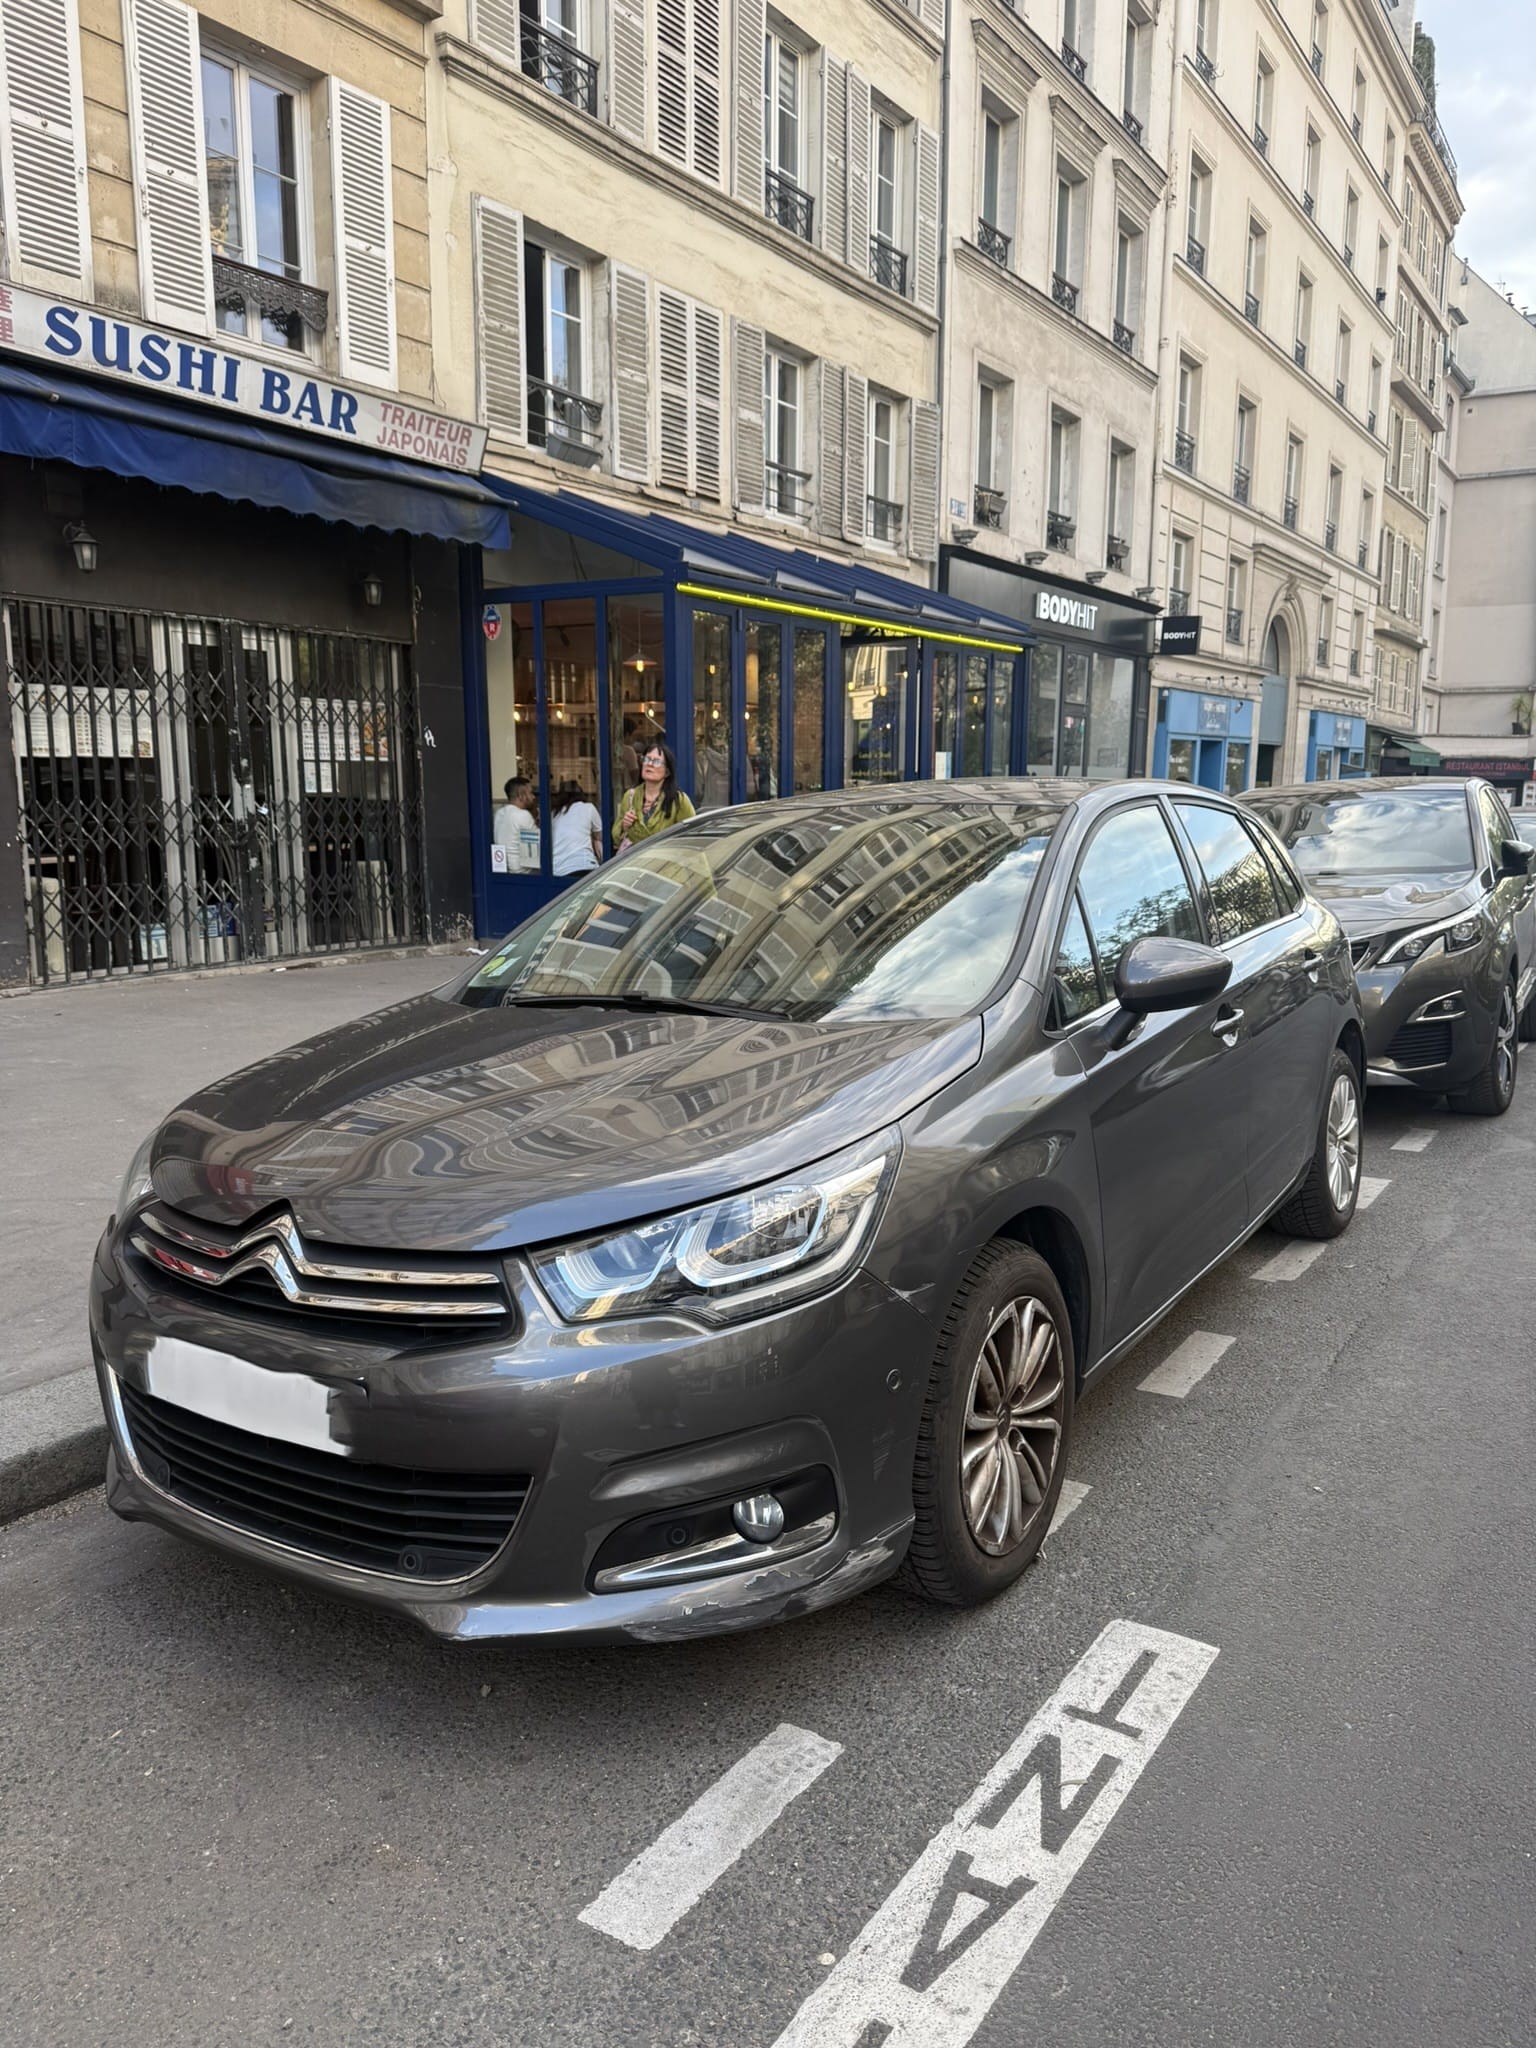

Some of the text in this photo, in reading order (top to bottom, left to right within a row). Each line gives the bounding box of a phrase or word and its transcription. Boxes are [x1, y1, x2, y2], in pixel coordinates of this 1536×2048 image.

[45, 306, 358, 434] SUSHI BAR
[379, 402, 472, 447] TRAITEUR
[376, 427, 469, 467] JAPONAIS
[1036, 592, 1098, 630] BODYHIT
[1163, 631, 1197, 640] BODYHIT
[1445, 761, 1494, 770] RESTAURANT
